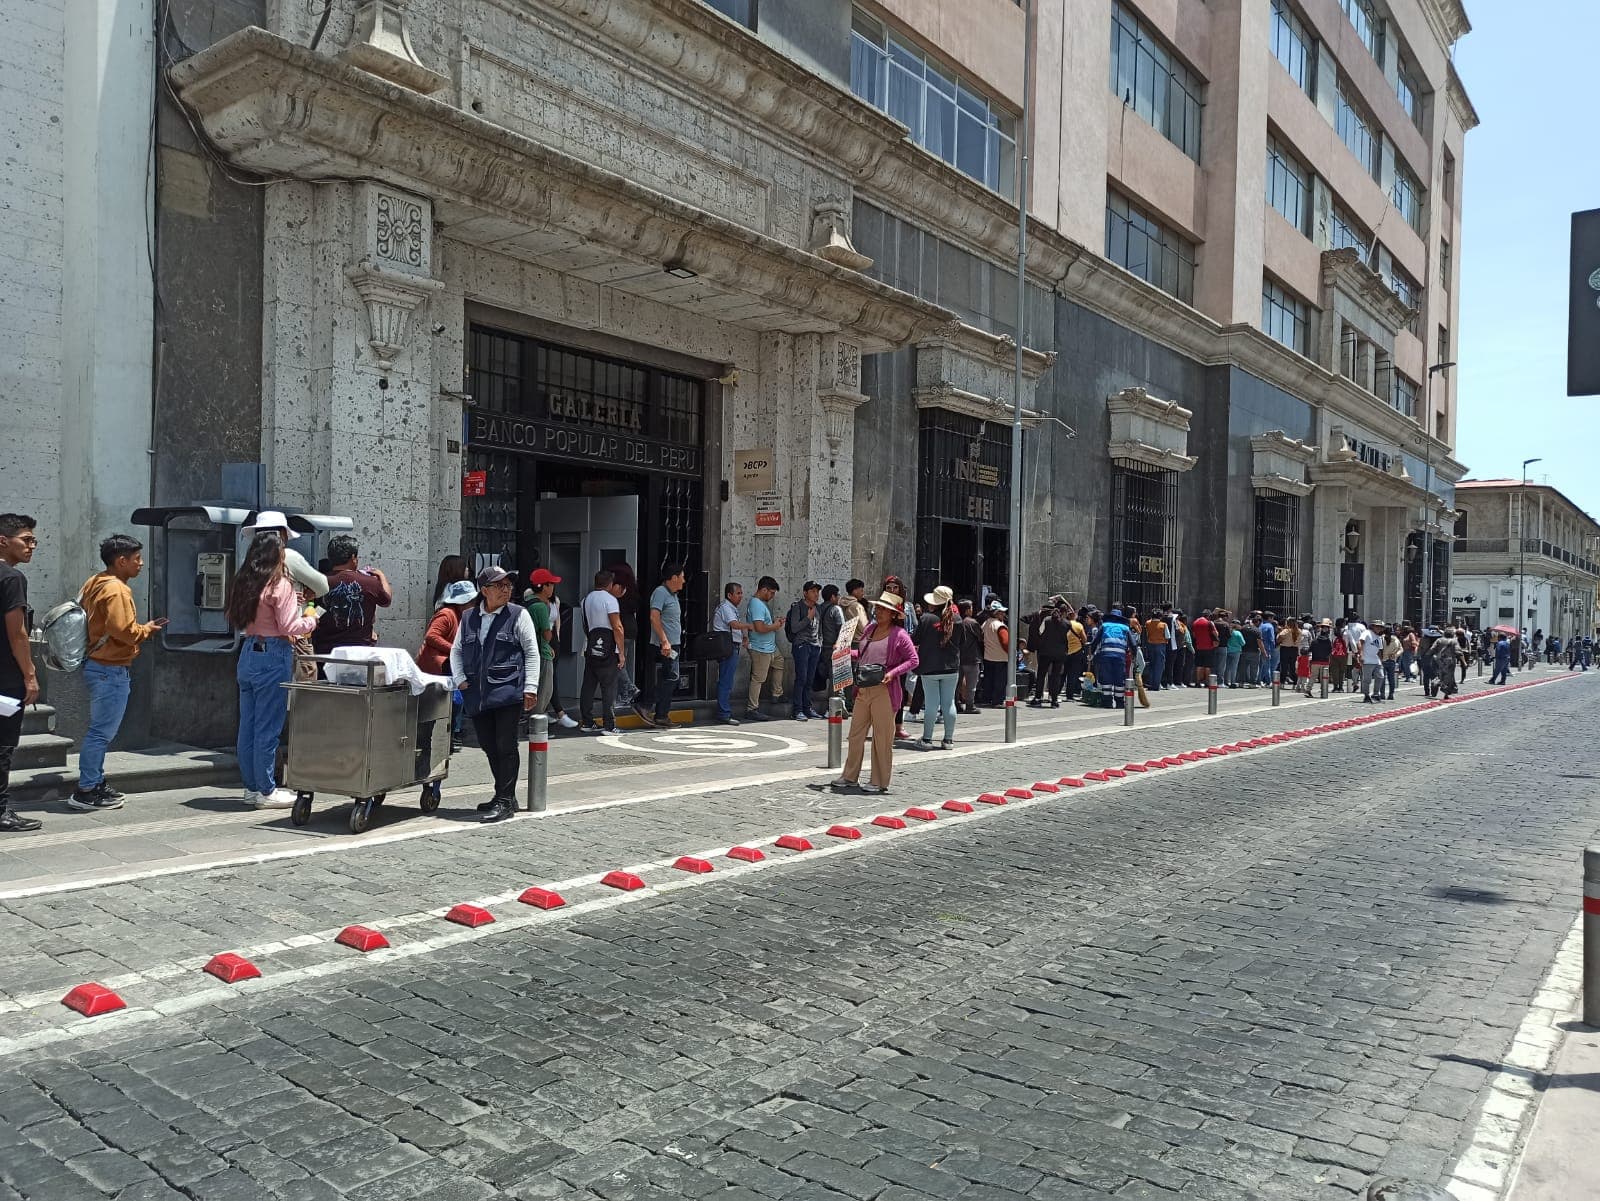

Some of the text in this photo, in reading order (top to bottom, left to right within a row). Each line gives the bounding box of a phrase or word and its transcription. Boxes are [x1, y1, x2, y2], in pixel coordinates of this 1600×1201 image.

[550, 393, 642, 429] GALERIA
[475, 416, 537, 446] BANCO
[544, 427, 619, 459] POPULAR
[625, 440, 653, 464] DEL
[660, 446, 696, 470] PERU
